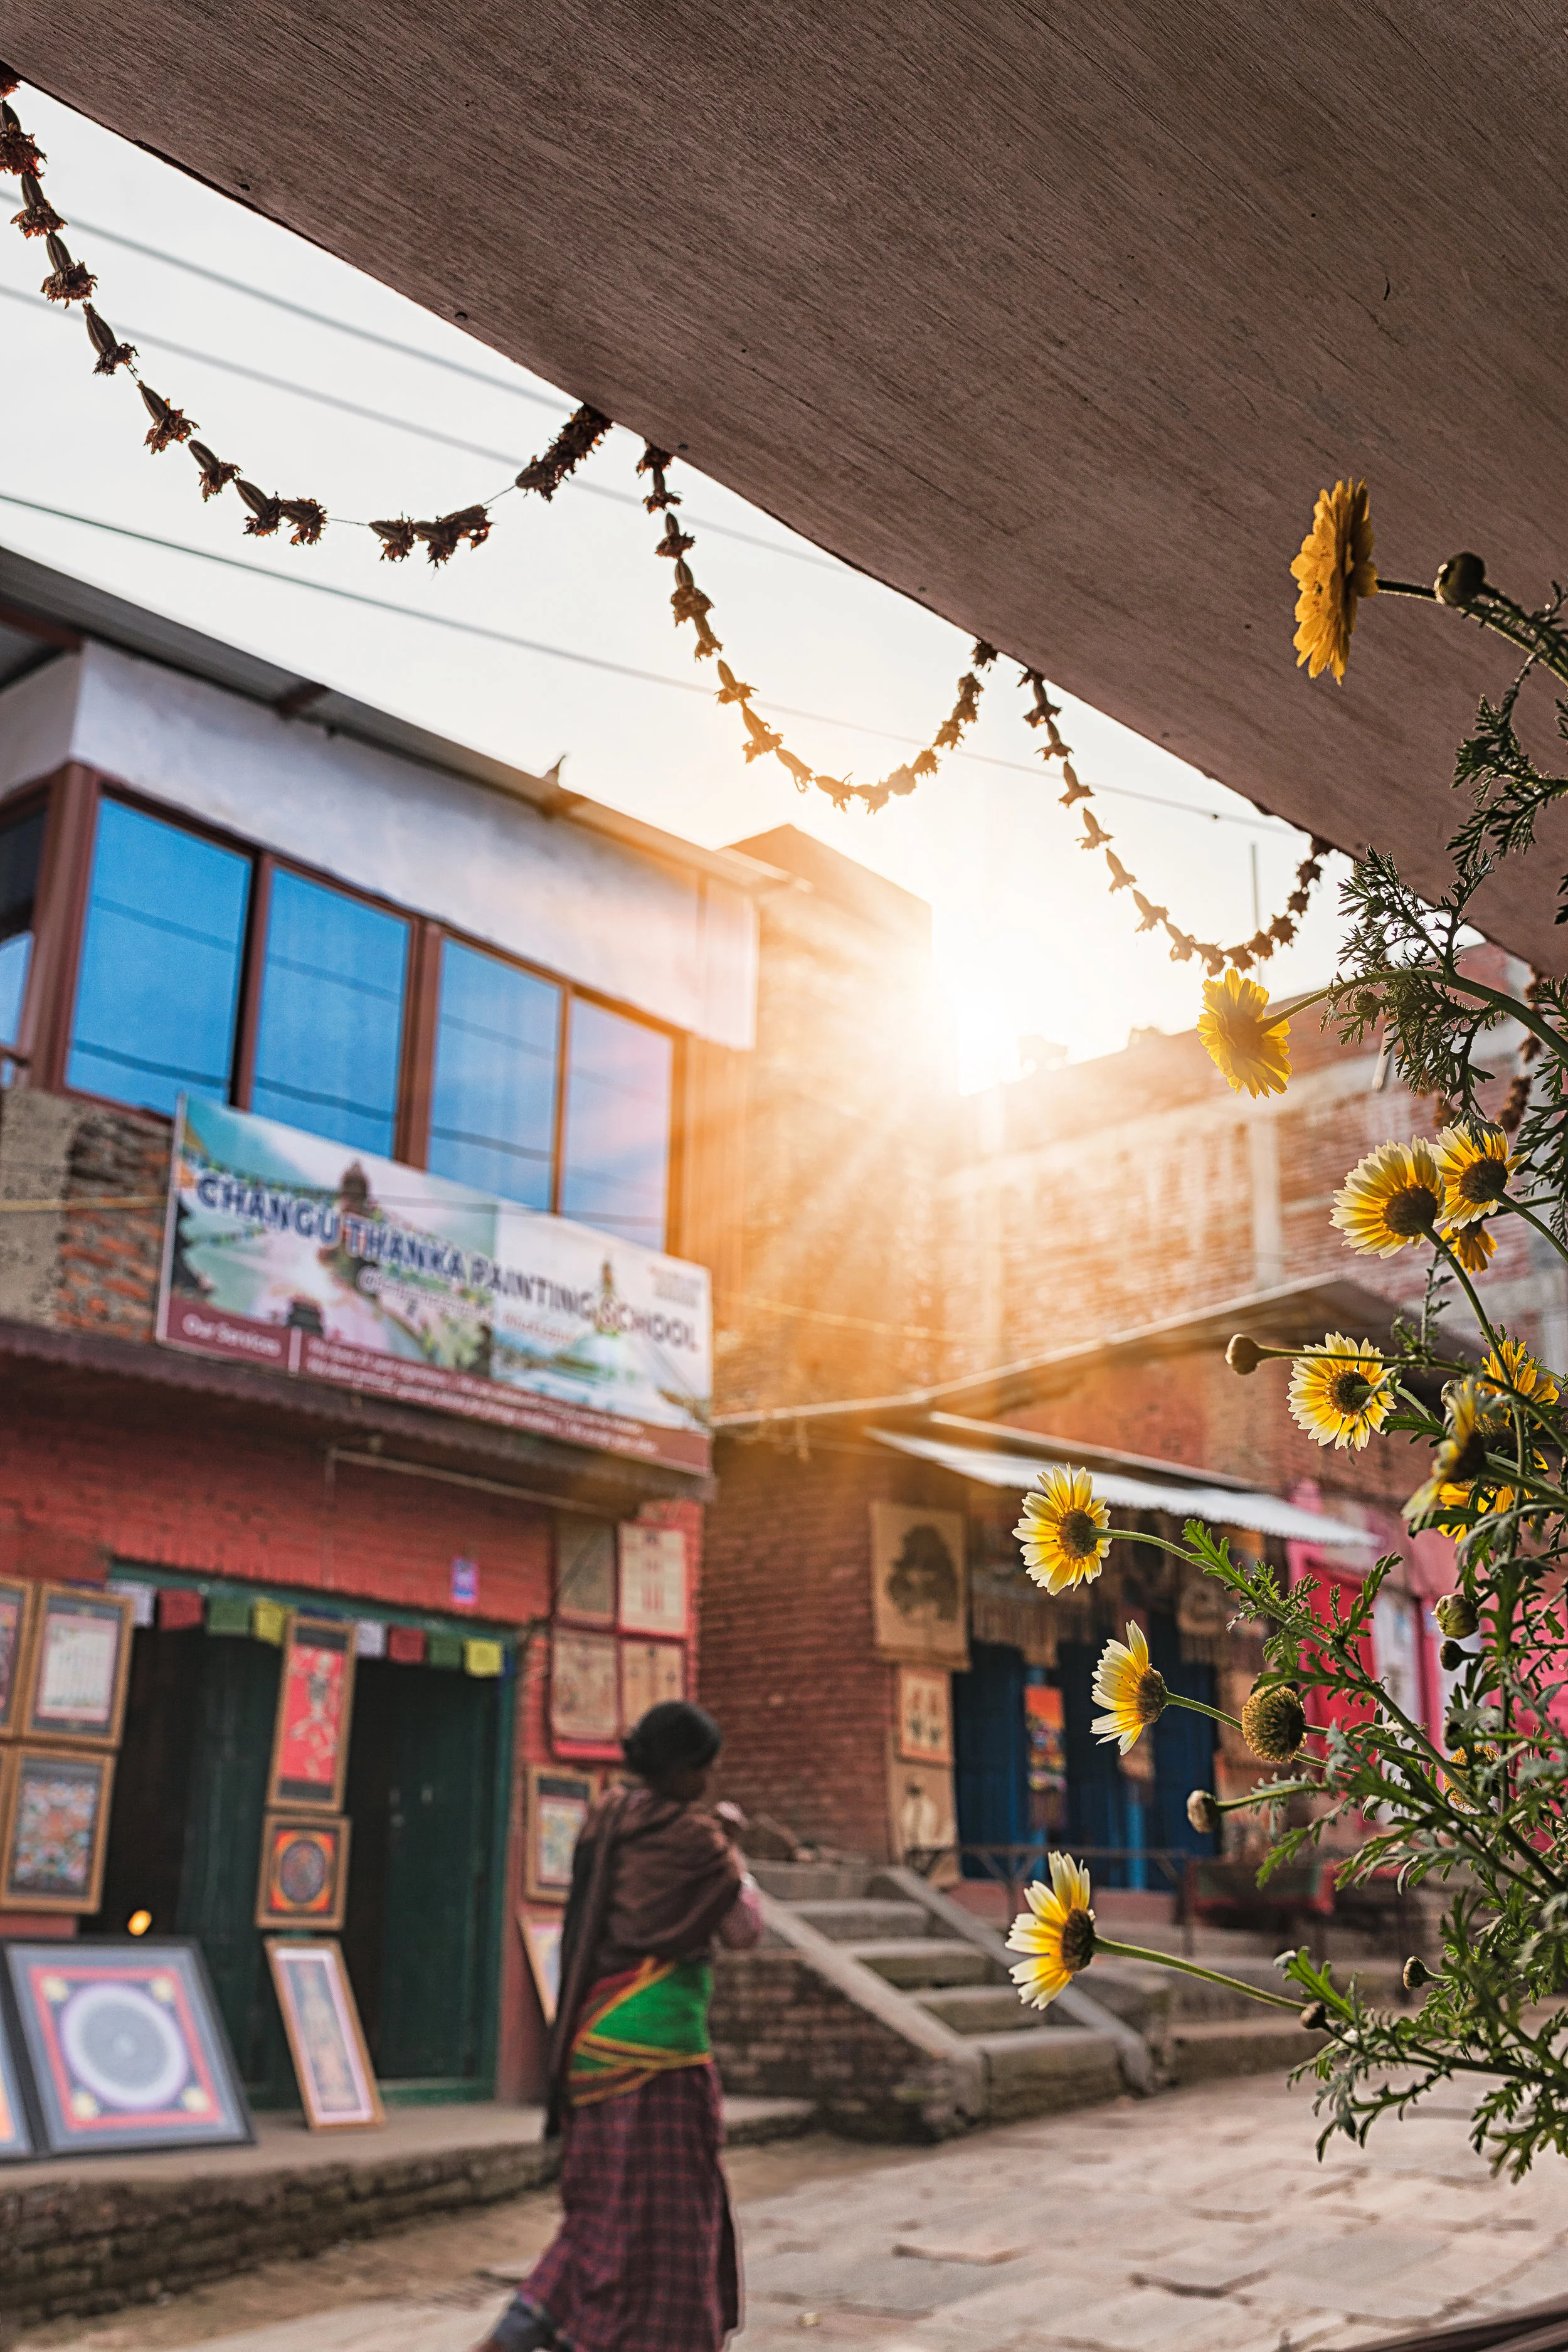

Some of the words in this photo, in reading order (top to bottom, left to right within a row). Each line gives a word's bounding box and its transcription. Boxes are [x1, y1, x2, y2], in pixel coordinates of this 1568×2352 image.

[196, 1173, 341, 1244] CHANGU
[344, 1216, 466, 1279] THANKA
[470, 1254, 596, 1319] PAINTING
[598, 1297, 700, 1353] SCHOOL
[183, 1313, 216, 1340] Our
